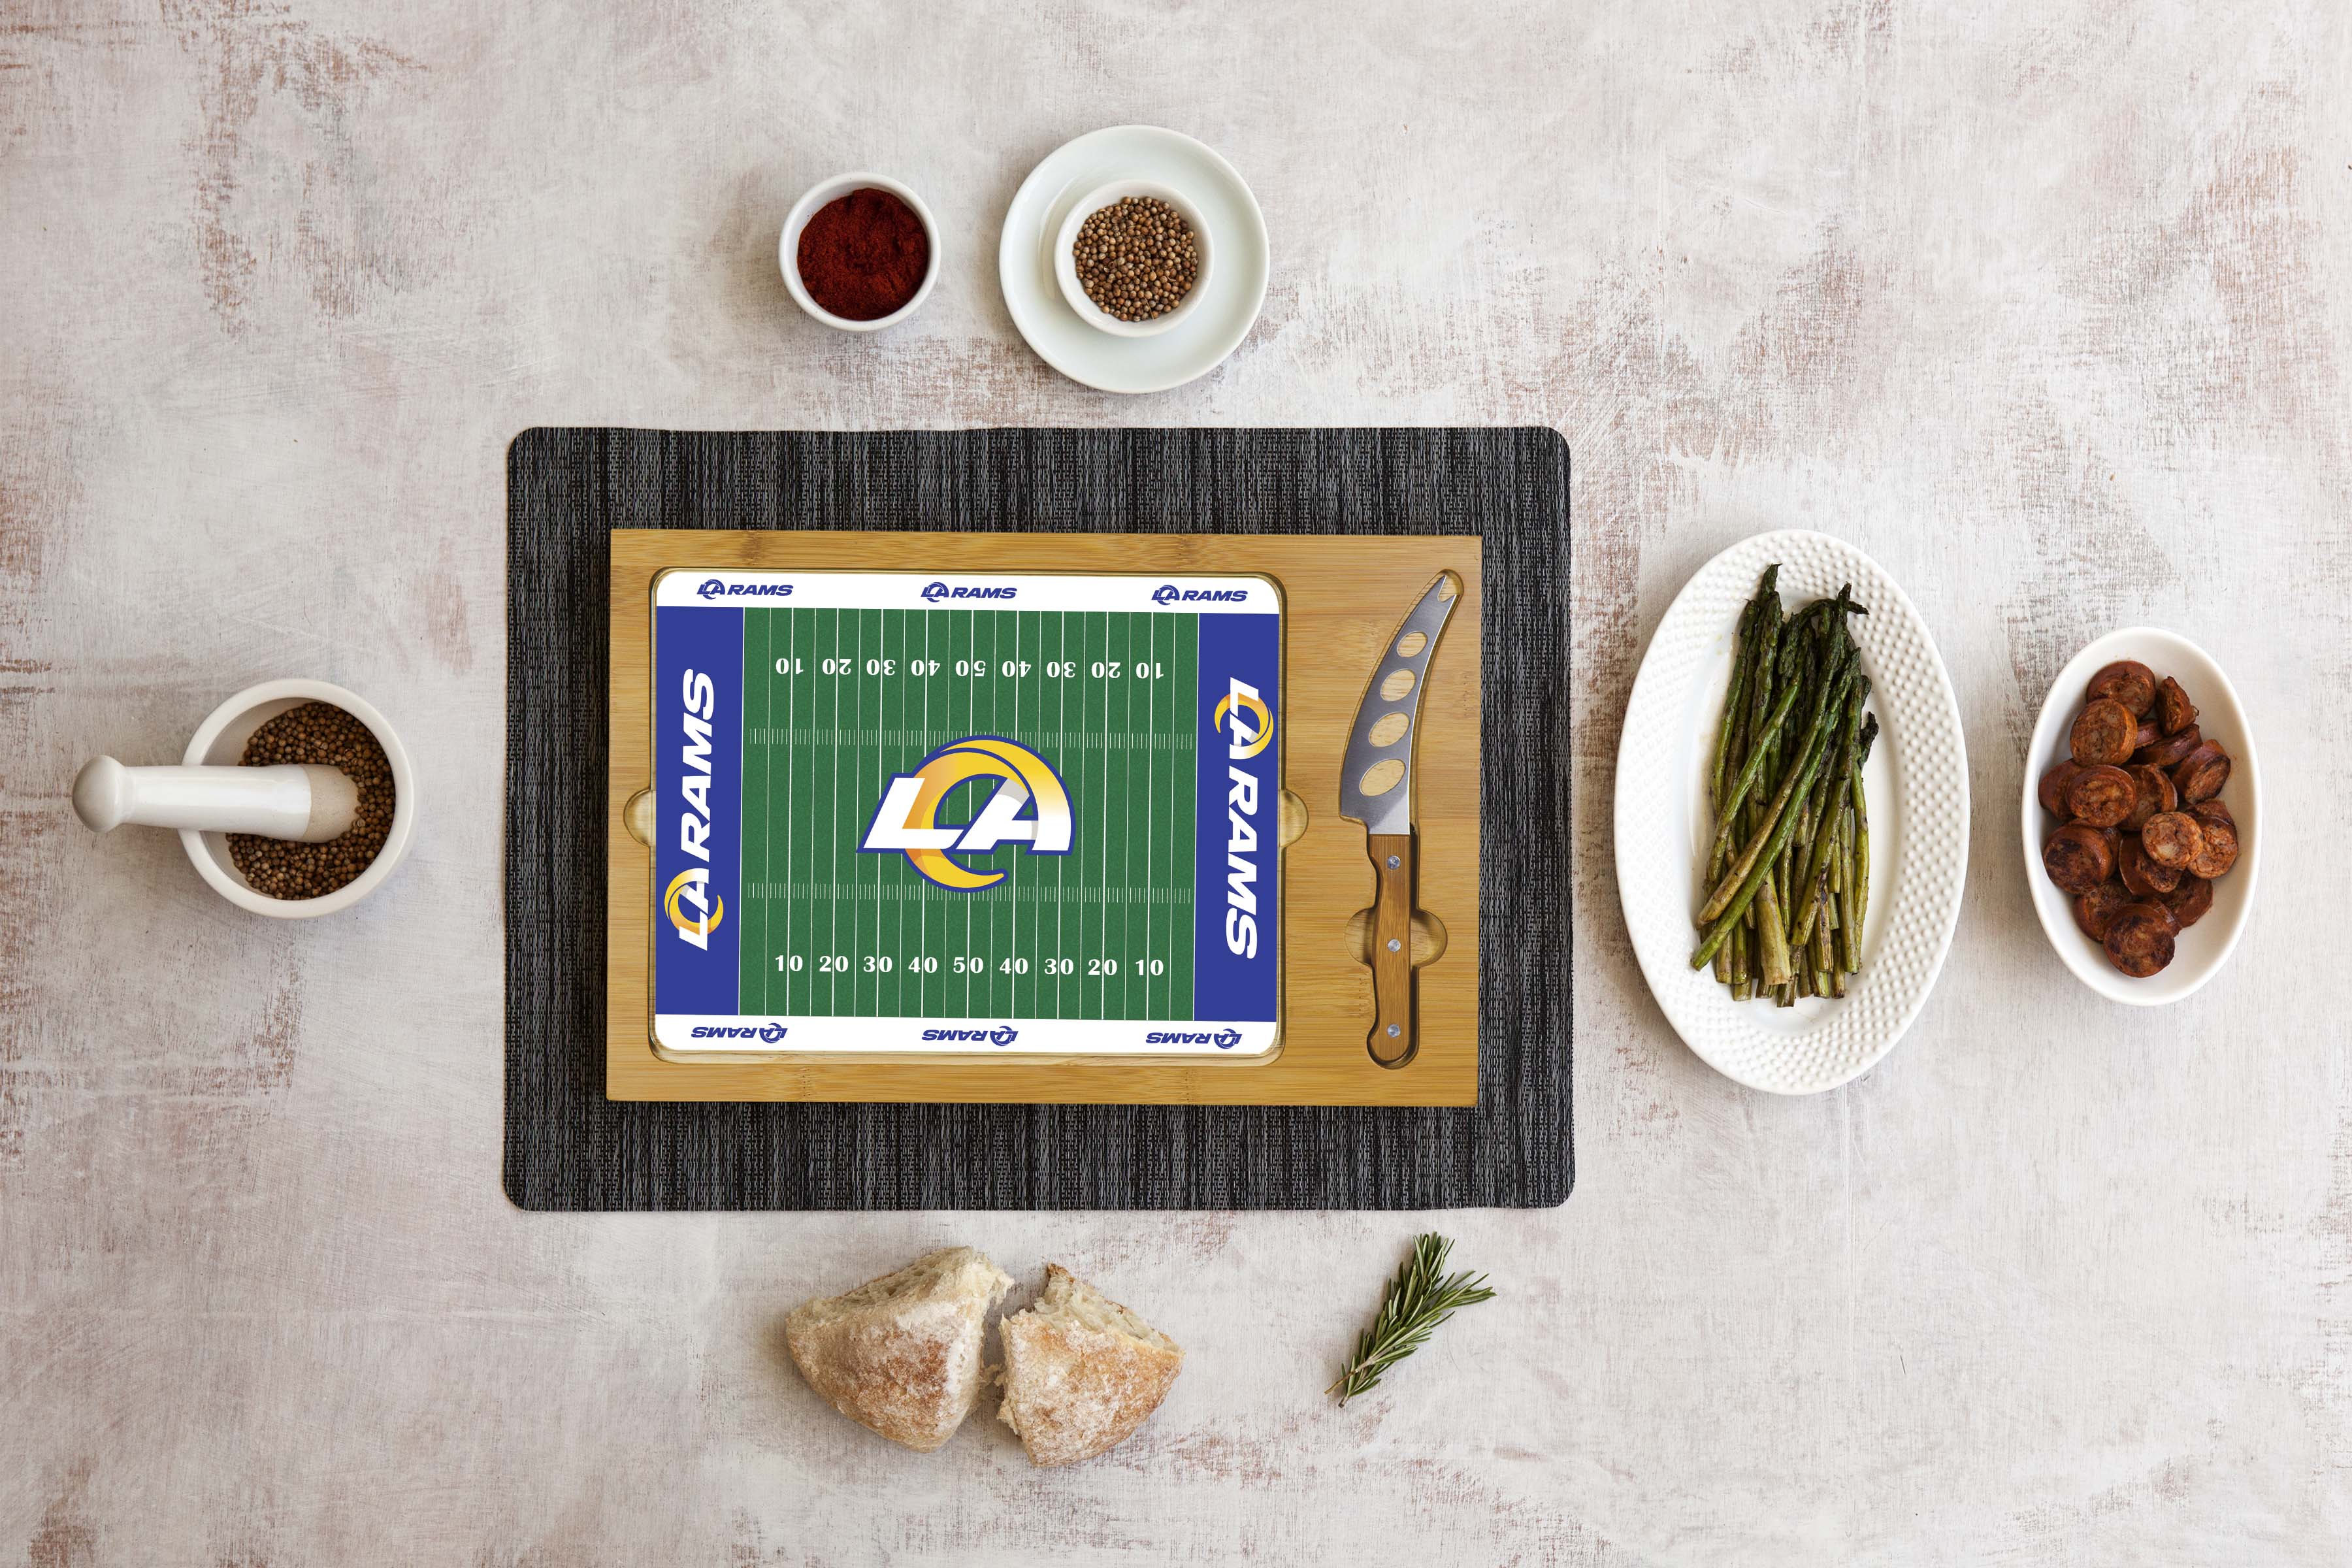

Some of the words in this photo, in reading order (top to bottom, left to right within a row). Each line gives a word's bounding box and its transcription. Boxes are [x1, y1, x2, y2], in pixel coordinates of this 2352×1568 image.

[727, 584, 793, 596] RAMS
[951, 587, 1017, 599] RAMS
[1181, 590, 1248, 602] RAMS
[776, 658, 804, 674] 10
[822, 658, 851, 676] 20
[866, 659, 896, 676] 30
[911, 659, 941, 676] 40
[955, 660, 987, 678] 50
[1002, 661, 1032, 678] 40
[1047, 661, 1076, 678] 30
[1091, 661, 1121, 679] 20
[1135, 662, 1164, 679] 10
[681, 668, 714, 862] RAMS
[856, 734, 1076, 893] LA
[1226, 765, 1258, 959] RAMS
[775, 955, 803, 972] 10
[819, 955, 849, 973] 20
[862, 956, 892, 973] 30
[907, 956, 938, 973] 40
[953, 956, 983, 973] 50
[999, 957, 1028, 975] 40
[1044, 958, 1074, 975] 30
[1088, 958, 1117, 975] 20
[1135, 959, 1164, 976] 10
[691, 1026, 759, 1039] RAMS
[921, 1029, 988, 1041] RAMS
[1145, 1032, 1213, 1045] RAMS
